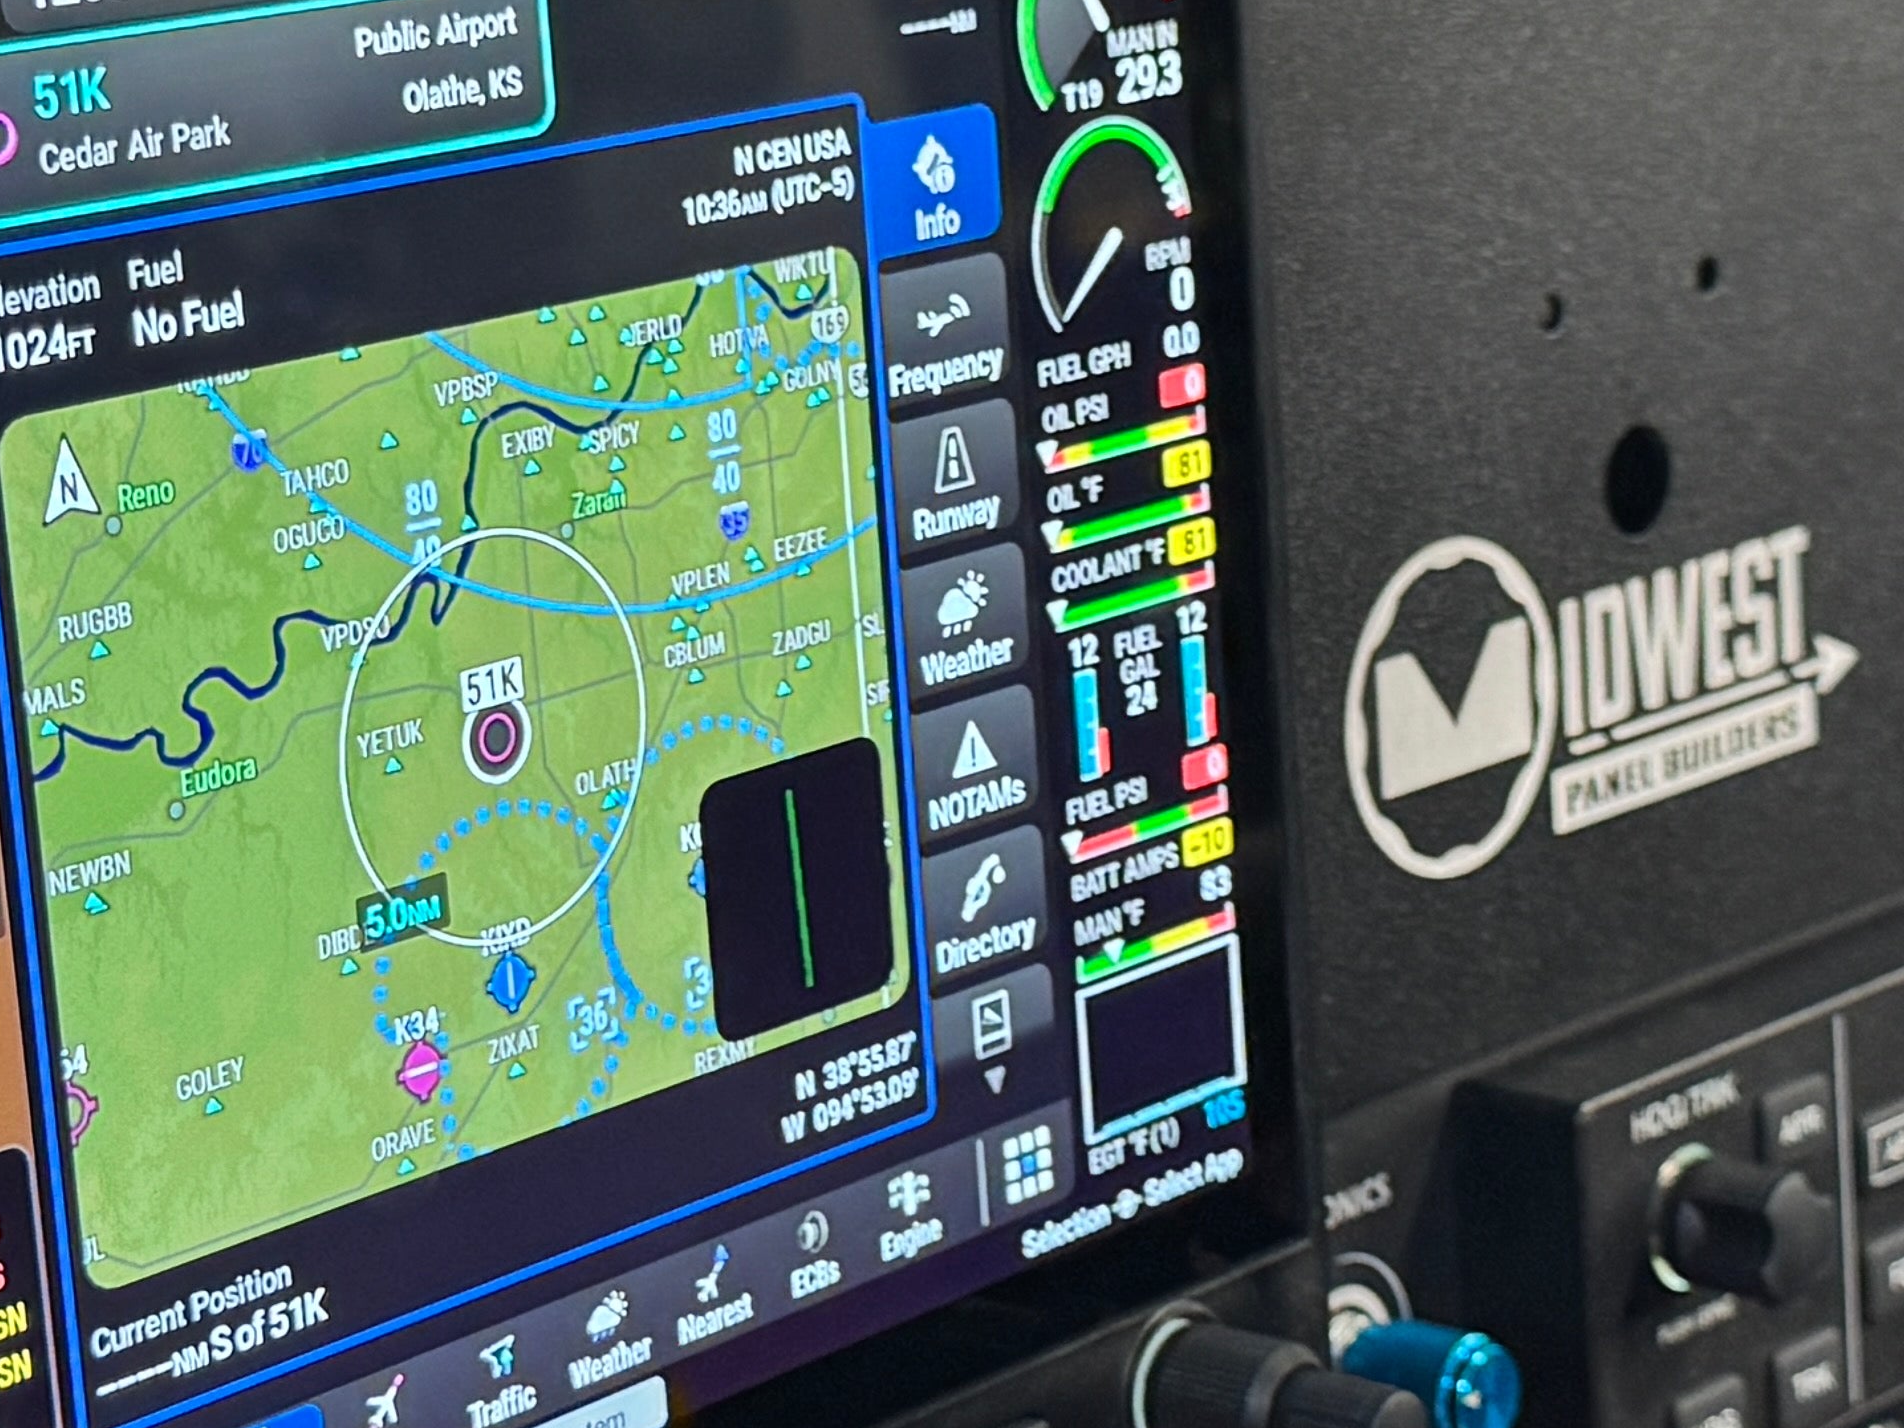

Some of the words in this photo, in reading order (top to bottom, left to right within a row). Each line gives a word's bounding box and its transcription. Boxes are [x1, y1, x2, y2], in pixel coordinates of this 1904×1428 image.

[353, 17, 432, 60] Public
[437, 7, 519, 48] Airport
[32, 67, 112, 120] 51K
[402, 71, 487, 118] Olathe,
[488, 66, 523, 103] KS
[39, 136, 119, 176] Cedar
[126, 127, 164, 164] Air
[171, 115, 233, 159] Park
[916, 206, 961, 242] Info
[126, 250, 184, 291] Fuel
[131, 310, 176, 350] No
[182, 291, 247, 336] Fuel
[433, 372, 498, 407] VPBSP
[888, 347, 1004, 398] Frequency
[501, 425, 556, 459] EXIBY
[588, 420, 640, 455] SPICY
[706, 409, 737, 440] 80
[117, 482, 176, 514] Reno
[280, 459, 350, 496] TAHCO
[405, 480, 438, 515] 80
[713, 462, 740, 492] 40
[913, 495, 1000, 541] Runway
[774, 528, 827, 563] EEZEE
[671, 562, 731, 599] VPLEN
[58, 602, 133, 644] RUGBB
[772, 620, 832, 656] ZADGU
[1176, 601, 1208, 634] 12
[920, 637, 1014, 686] Weather
[1068, 633, 1099, 667] 12
[1113, 624, 1163, 659] FUEL
[466, 664, 518, 707] 51K
[1125, 683, 1157, 716] 24
[357, 719, 425, 758] YETUK
[180, 756, 257, 799] Eudora
[1567, 759, 1654, 815] PANEL
[1662, 707, 1798, 783] BUILDERS
[928, 775, 1027, 831] NOTAMs
[49, 851, 132, 897] NEWBN
[936, 917, 1037, 974] Directory
[394, 1007, 439, 1044] K34
[487, 1025, 540, 1065] ZIXAT
[176, 1056, 244, 1101] GOLEY
[371, 1119, 437, 1161] ORAVE
[880, 1219, 943, 1263] Engine
[92, 1288, 186, 1360] Current
[189, 1264, 292, 1319] Position
[677, 1295, 754, 1345] Nearest
[568, 1336, 653, 1389] Weather
